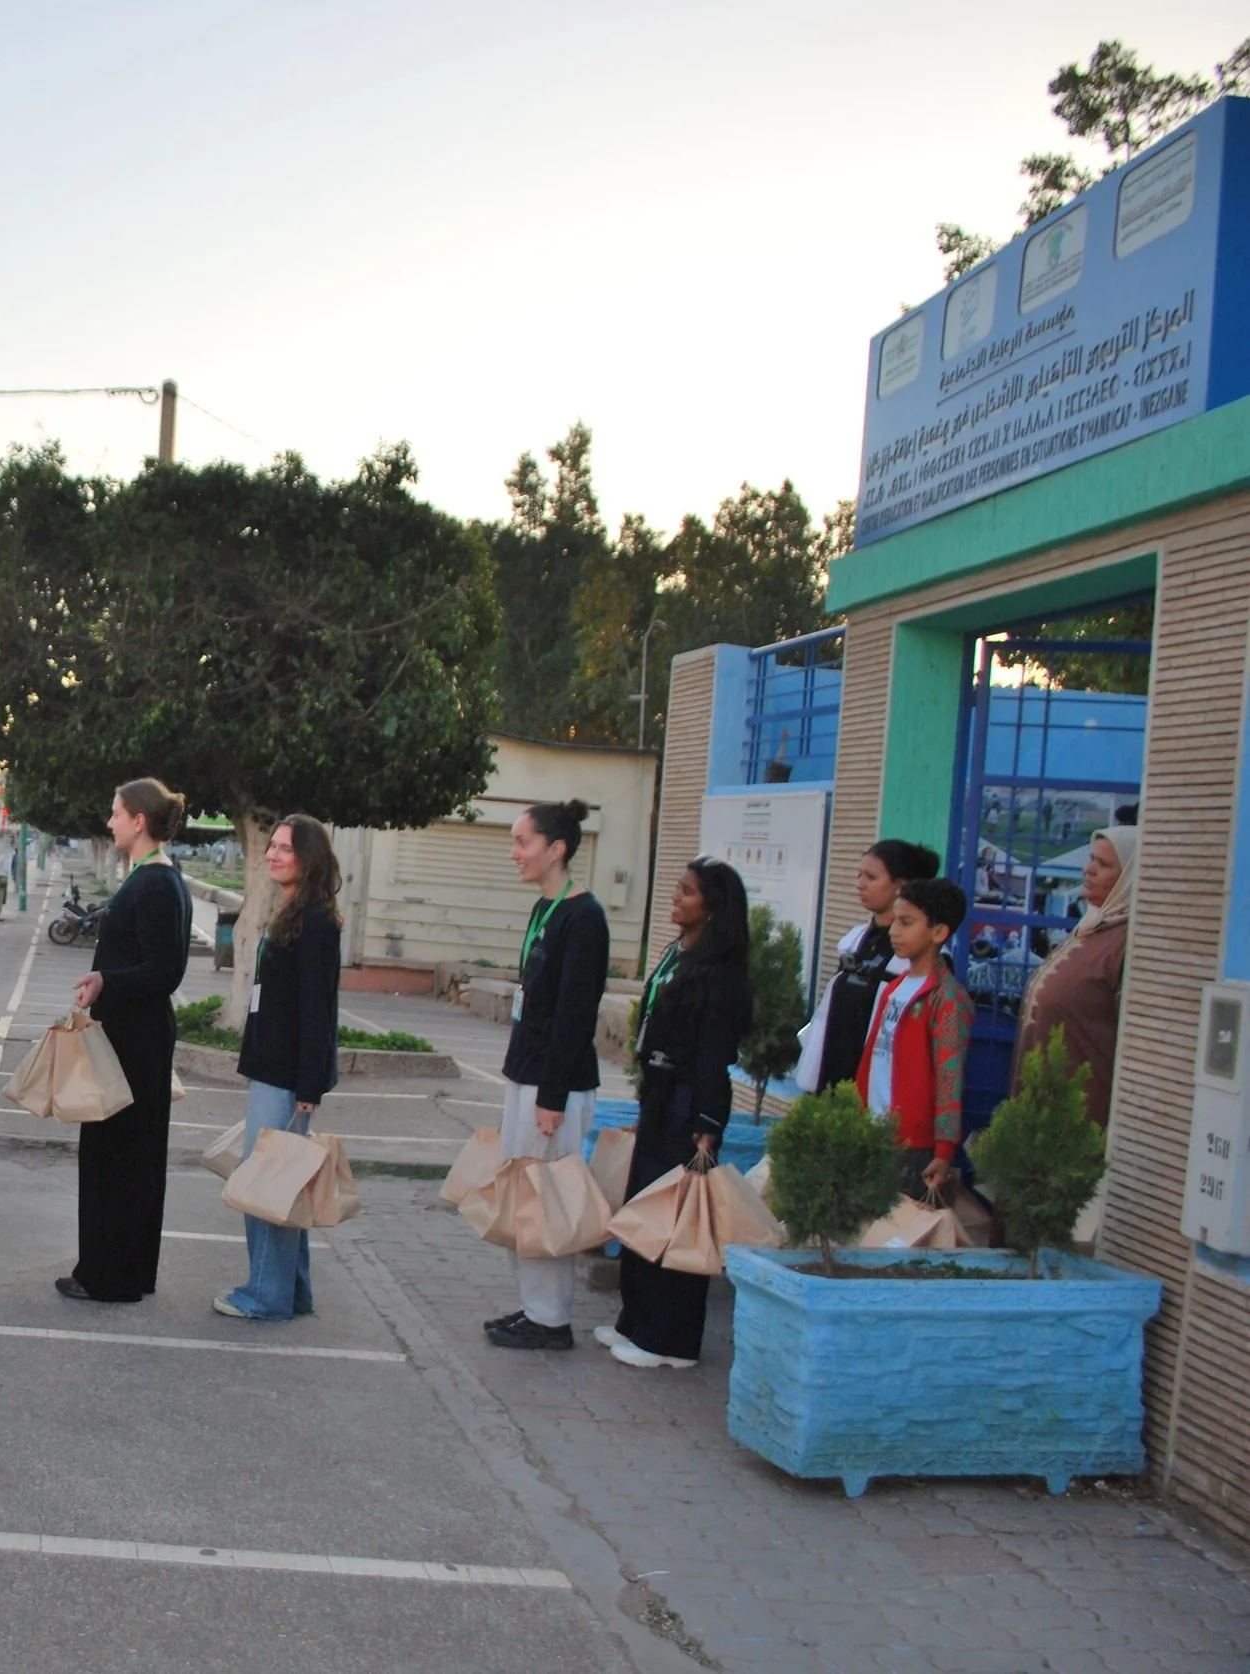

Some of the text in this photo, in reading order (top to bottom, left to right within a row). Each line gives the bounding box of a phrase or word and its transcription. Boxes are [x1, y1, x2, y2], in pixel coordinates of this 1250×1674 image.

[1025, 303, 1075, 343] مؤسسة
[1085, 316, 1139, 374] التربوي
[1141, 288, 1195, 352] المركز
[989, 335, 1022, 365] الرعاية
[965, 468, 977, 489] DES
[980, 451, 1019, 483] PERSONNES
[1020, 445, 1029, 468] EN
[1032, 424, 1077, 461] SITUATIONS
[1139, 378, 1188, 421] INEZGANE
